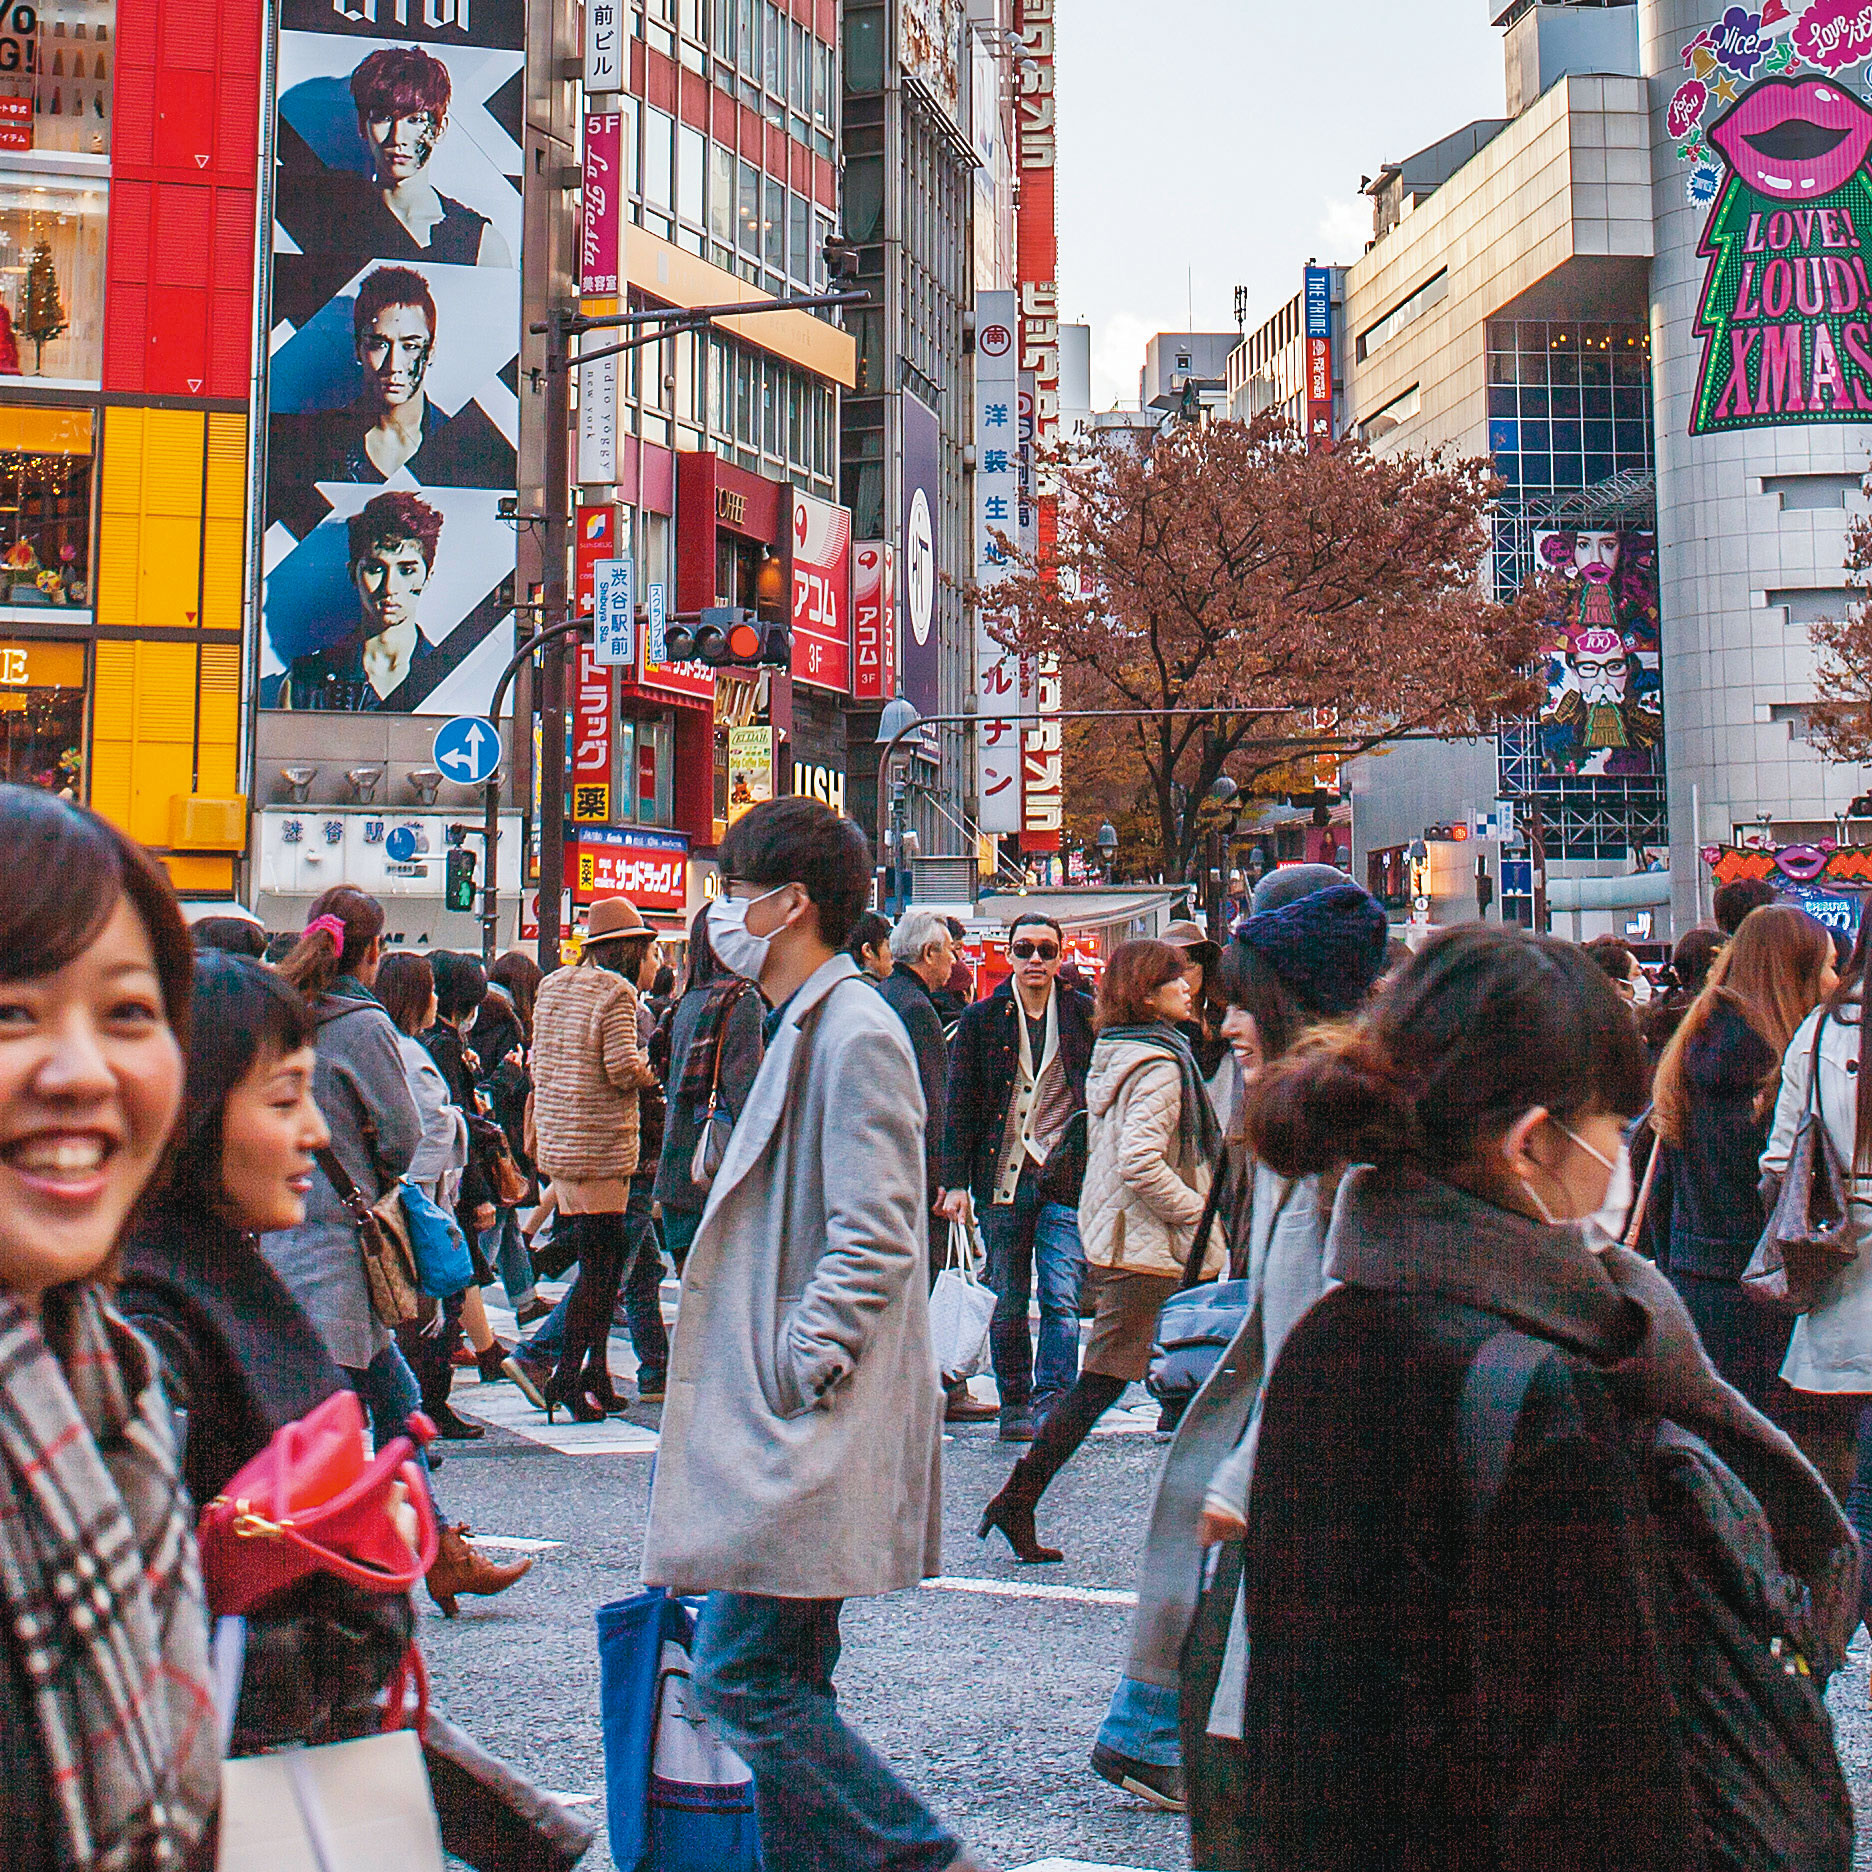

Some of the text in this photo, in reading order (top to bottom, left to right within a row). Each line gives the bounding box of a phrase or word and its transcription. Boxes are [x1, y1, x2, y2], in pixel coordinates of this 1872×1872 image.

[1718, 16, 1761, 57] Nice!
[1806, 16, 1848, 65] Love
[586, 114, 620, 137] 5F
[1744, 207, 1860, 252] LOVE!
[582, 274, 618, 294] 美容室
[1310, 276, 1327, 336] THE PRIME
[585, 370, 594, 399] new
[599, 581, 609, 625] Shibuya
[610, 566, 629, 656] 渋谷駅前
[793, 569, 837, 629] アコム
[857, 605, 877, 665] アコム
[808, 644, 823, 673] 3F
[860, 671, 877, 686] 3F
[576, 787, 607, 818] 薬
[614, 858, 672, 893] サンドラッグ
